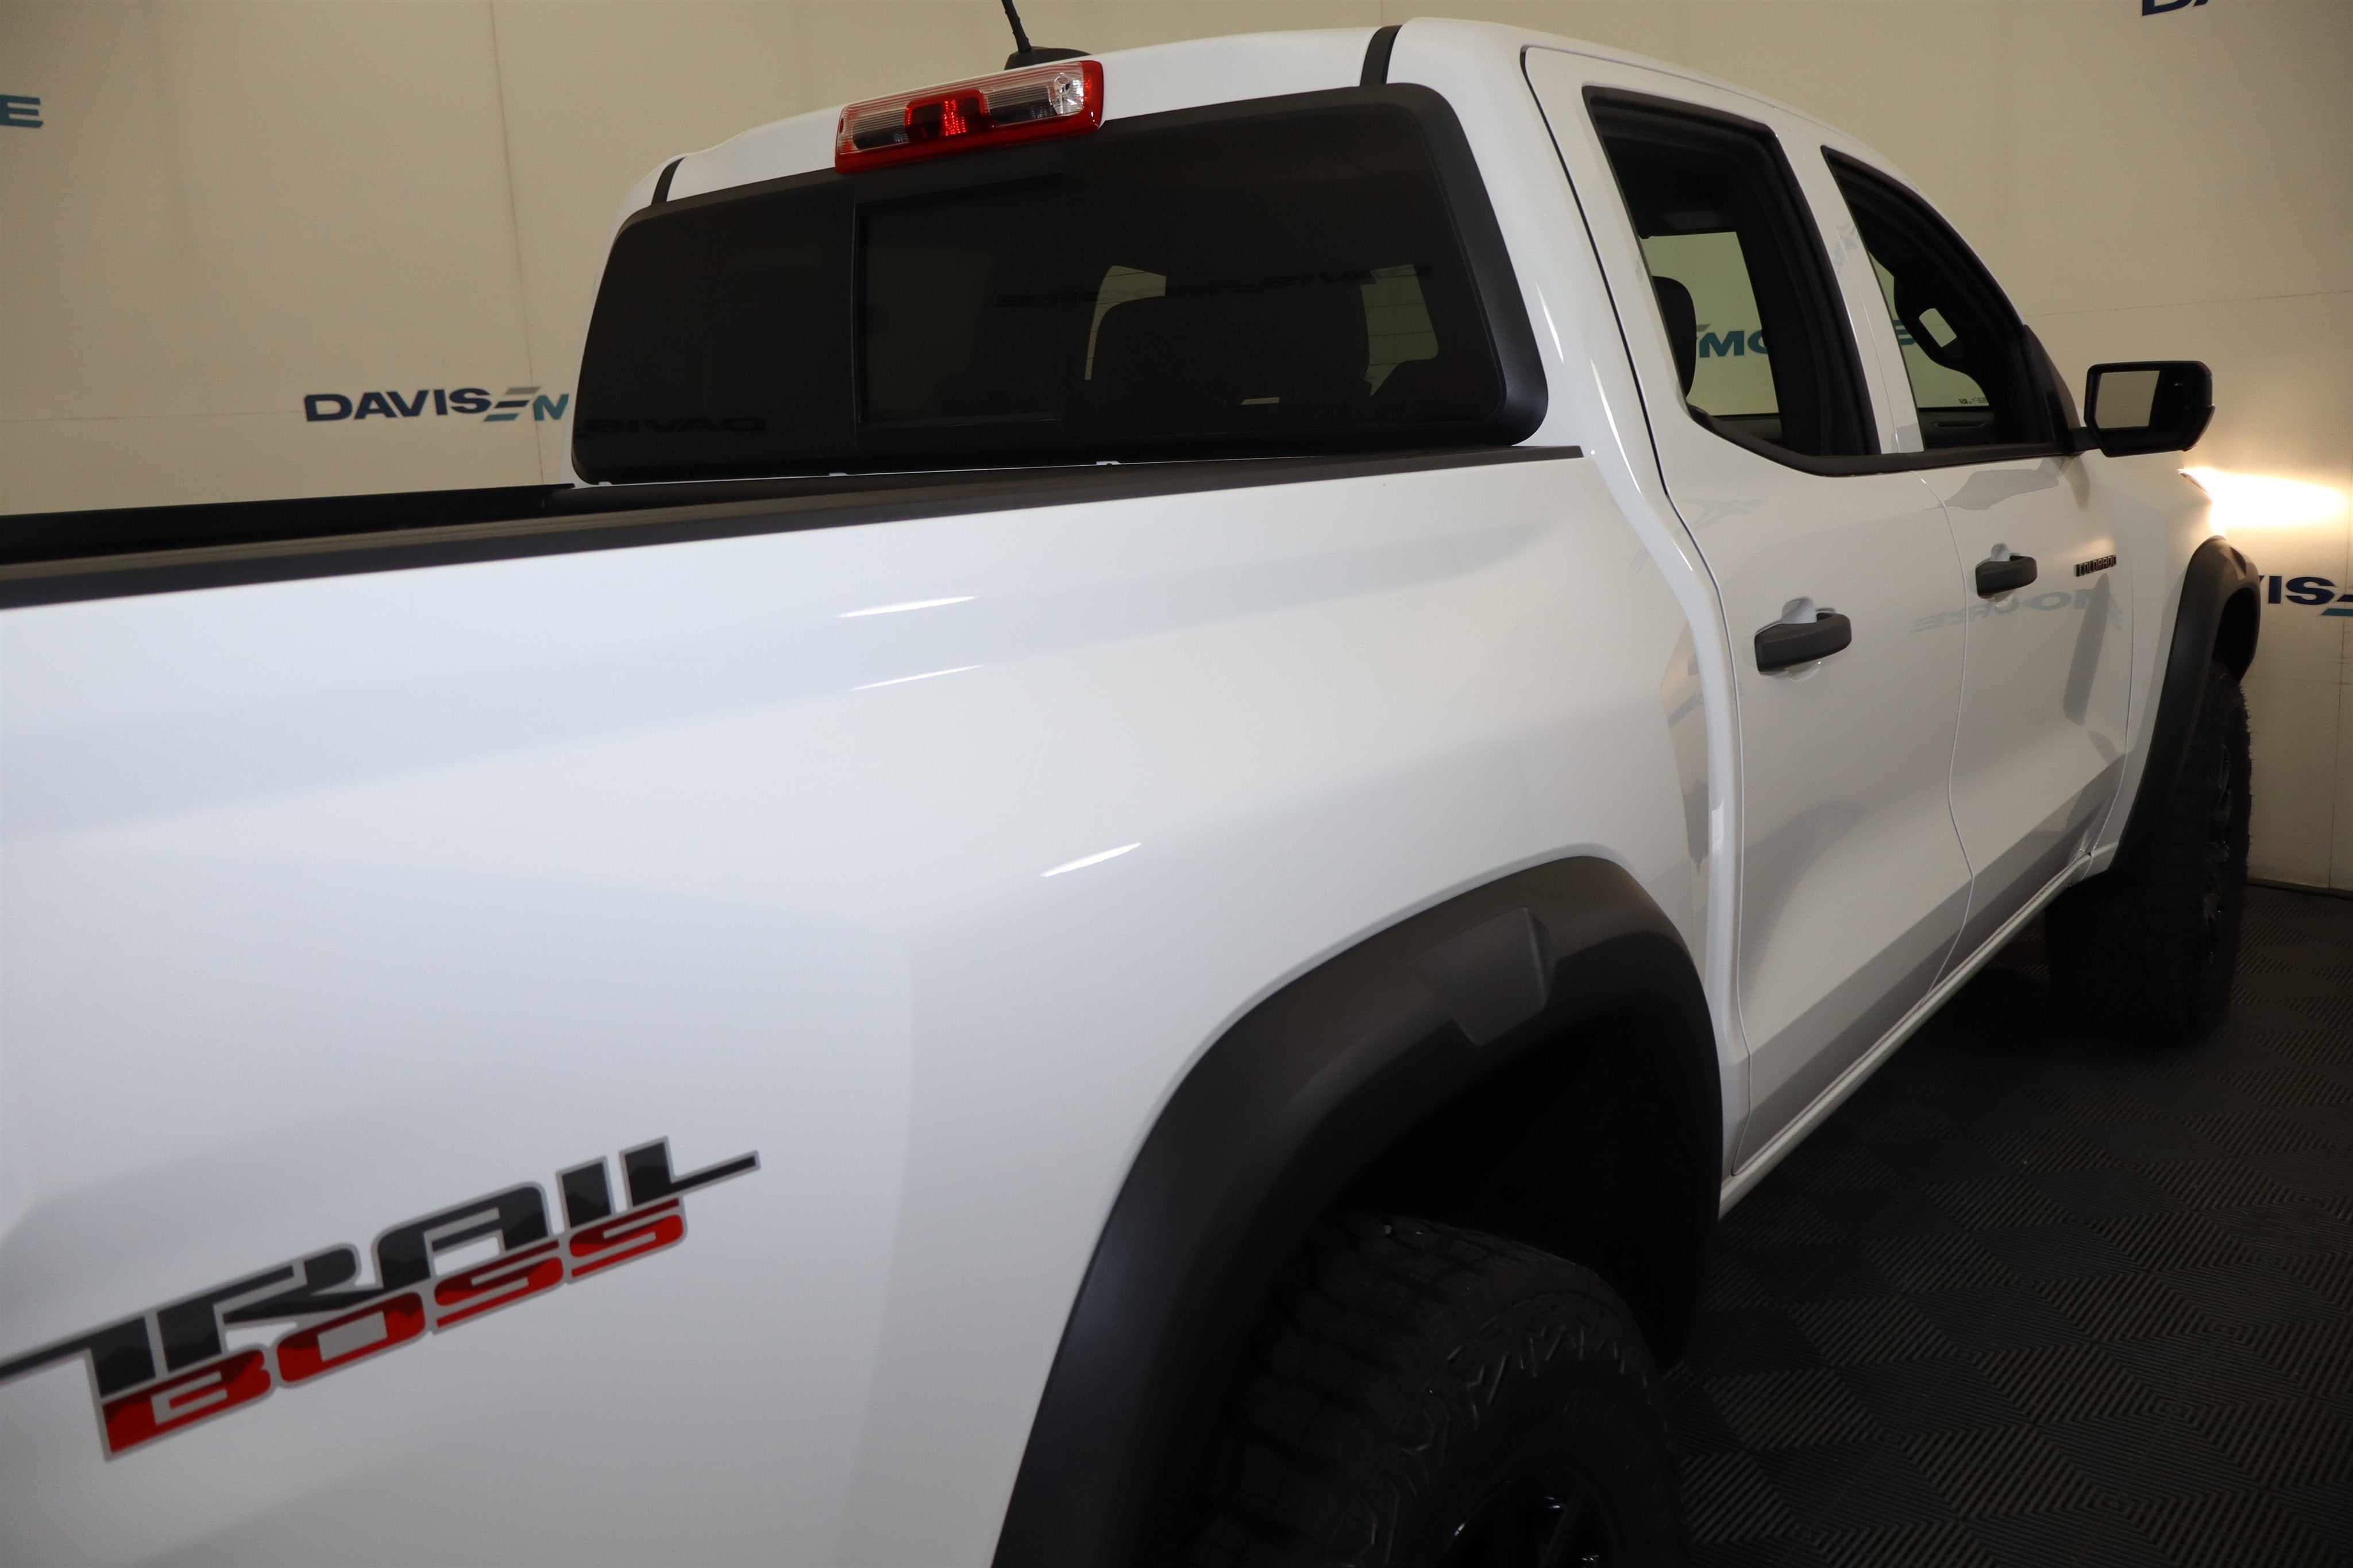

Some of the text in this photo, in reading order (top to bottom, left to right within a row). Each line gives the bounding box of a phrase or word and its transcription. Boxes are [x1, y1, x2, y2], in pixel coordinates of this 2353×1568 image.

[304, 387, 493, 422] DAVIS
[2076, 554, 2117, 577] COLORADO
[0, 1137, 759, 1399] TRAIL
[100, 1197, 687, 1460] BOSS
